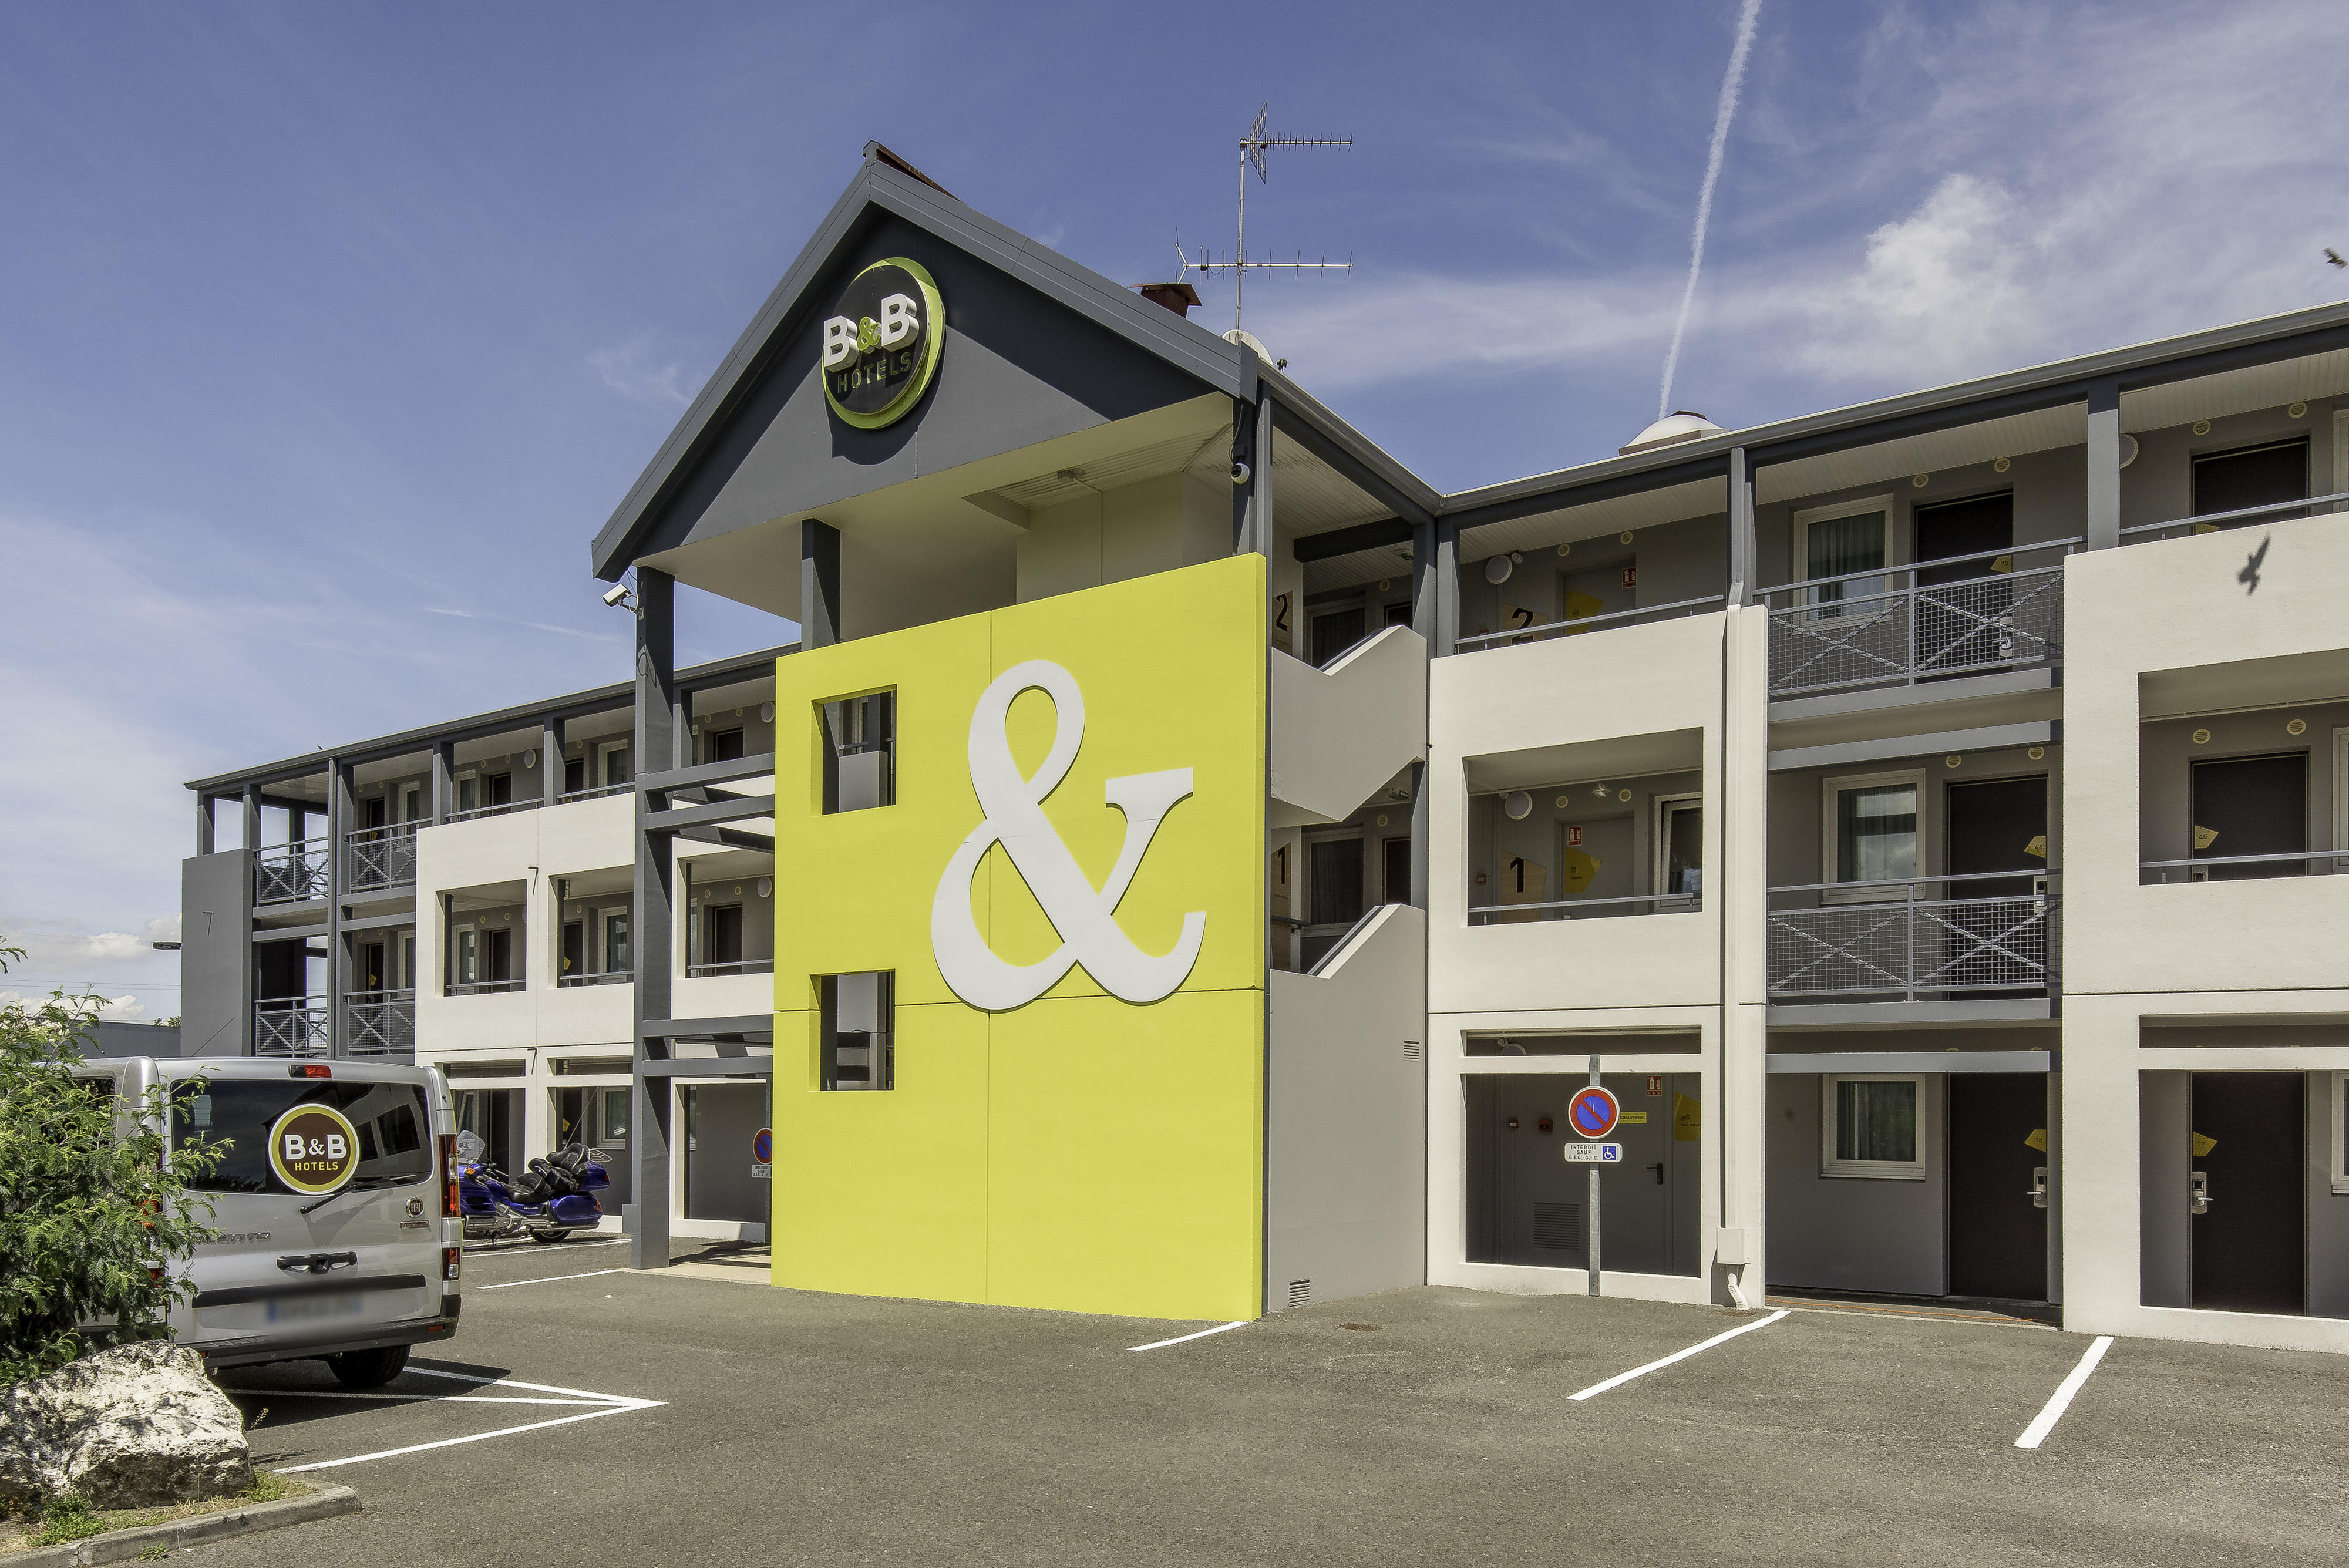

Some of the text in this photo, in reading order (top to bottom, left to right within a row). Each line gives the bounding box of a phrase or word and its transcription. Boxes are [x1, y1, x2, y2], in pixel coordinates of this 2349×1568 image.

[824, 293, 918, 371] B&B
[837, 352, 911, 394] HOTELS
[1276, 594, 1288, 632] 2
[1512, 607, 1534, 645] 2
[931, 659, 1206, 1014] &
[1277, 847, 1285, 885] 1
[1510, 856, 1525, 893] 1
[285, 1134, 347, 1160] B&B
[295, 1162, 339, 1172] HOTELS
[410, 1203, 421, 1213] FIAT
